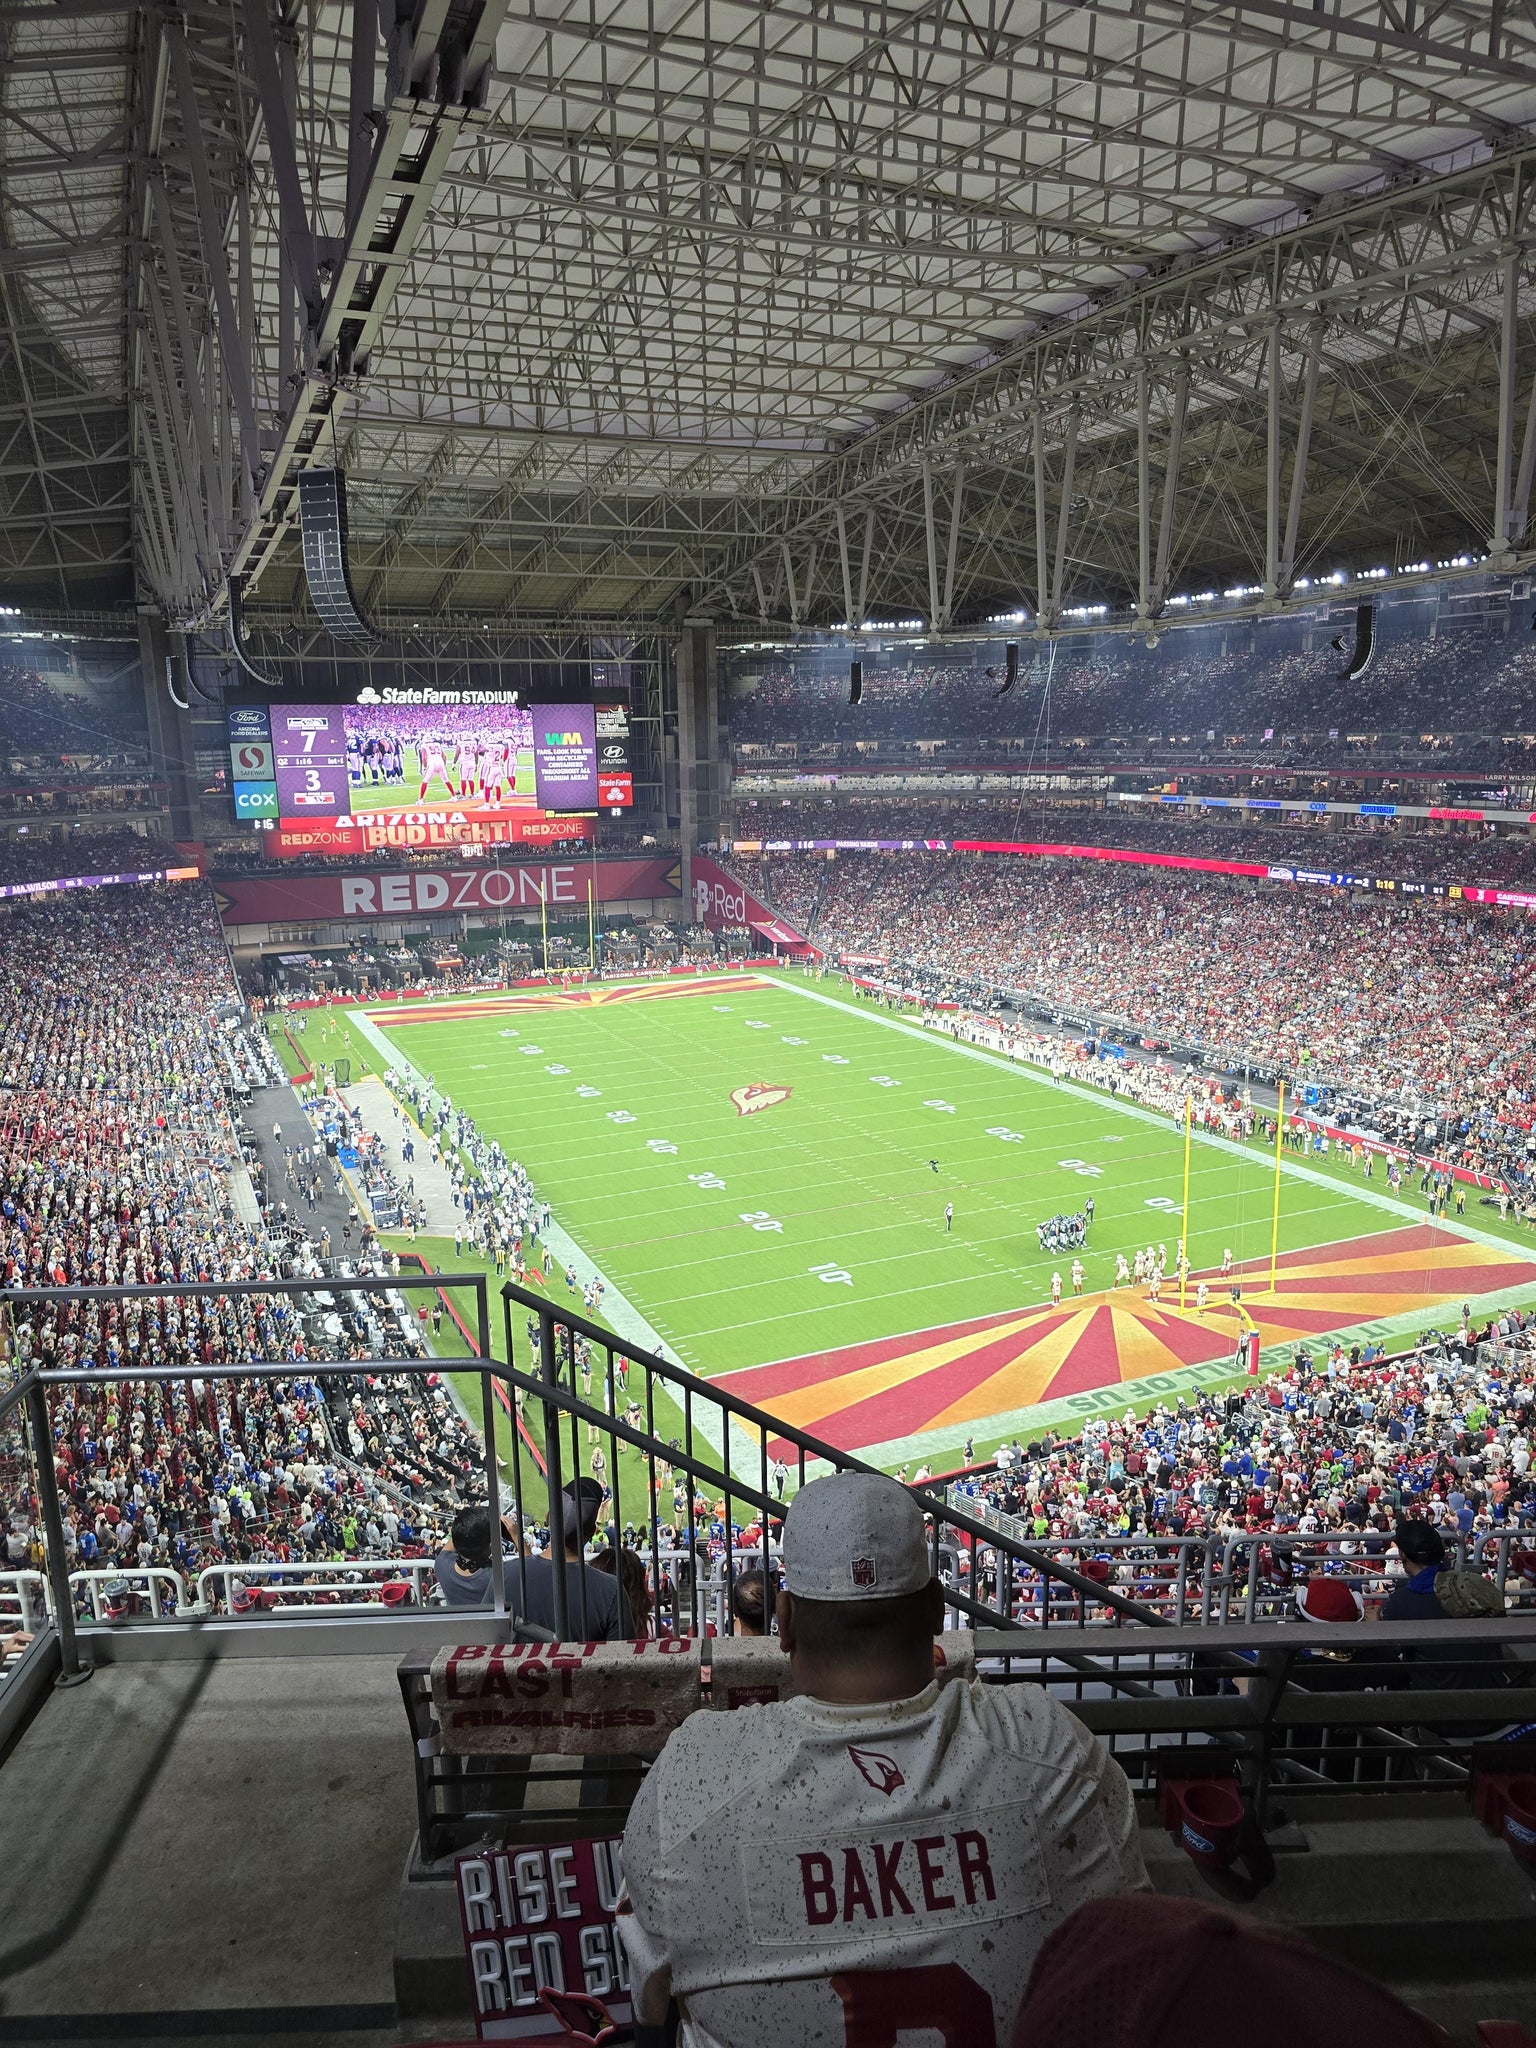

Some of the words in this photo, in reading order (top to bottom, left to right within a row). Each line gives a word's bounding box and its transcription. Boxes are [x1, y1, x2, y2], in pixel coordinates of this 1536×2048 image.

[462, 691, 518, 704] STADIUM
[236, 712, 259, 723] Ford
[300, 731, 316, 752] 7
[545, 732, 583, 746] WM
[277, 758, 288, 766] Q2
[305, 769, 321, 791] 3
[238, 794, 275, 806] COX
[1309, 802, 1326, 810] COX
[369, 825, 426, 846] BUD
[430, 822, 507, 844] LIGHT
[798, 841, 814, 849] 116
[902, 840, 913, 849] 59
[341, 866, 576, 914] REDZONE
[1336, 874, 1343, 884] 7
[1376, 879, 1395, 890] 1:16
[1477, 890, 1485, 900] 3
[869, 1075, 902, 1087] 50
[606, 1110, 637, 1123] 50
[985, 1126, 1025, 1142] 30
[646, 1139, 678, 1155] 40
[1362, 1140, 1391, 1155] ARIZONA
[1057, 1159, 1105, 1177] 20
[687, 1171, 725, 1190] 30
[739, 1210, 782, 1232] 20
[807, 1262, 852, 1284] 10
[1365, 1323, 1396, 1338] IT
[1128, 1376, 1178, 1399] OF
[1069, 1390, 1124, 1413] US
[450, 1641, 606, 1661] BUILT
[627, 1638, 692, 1655] TO
[445, 1658, 583, 1700] LAST
[452, 1708, 657, 1730] RIVALRIES
[796, 1830, 997, 1926] BAKER
[460, 1846, 581, 1934] RISE
[470, 1931, 566, 2015] RED
